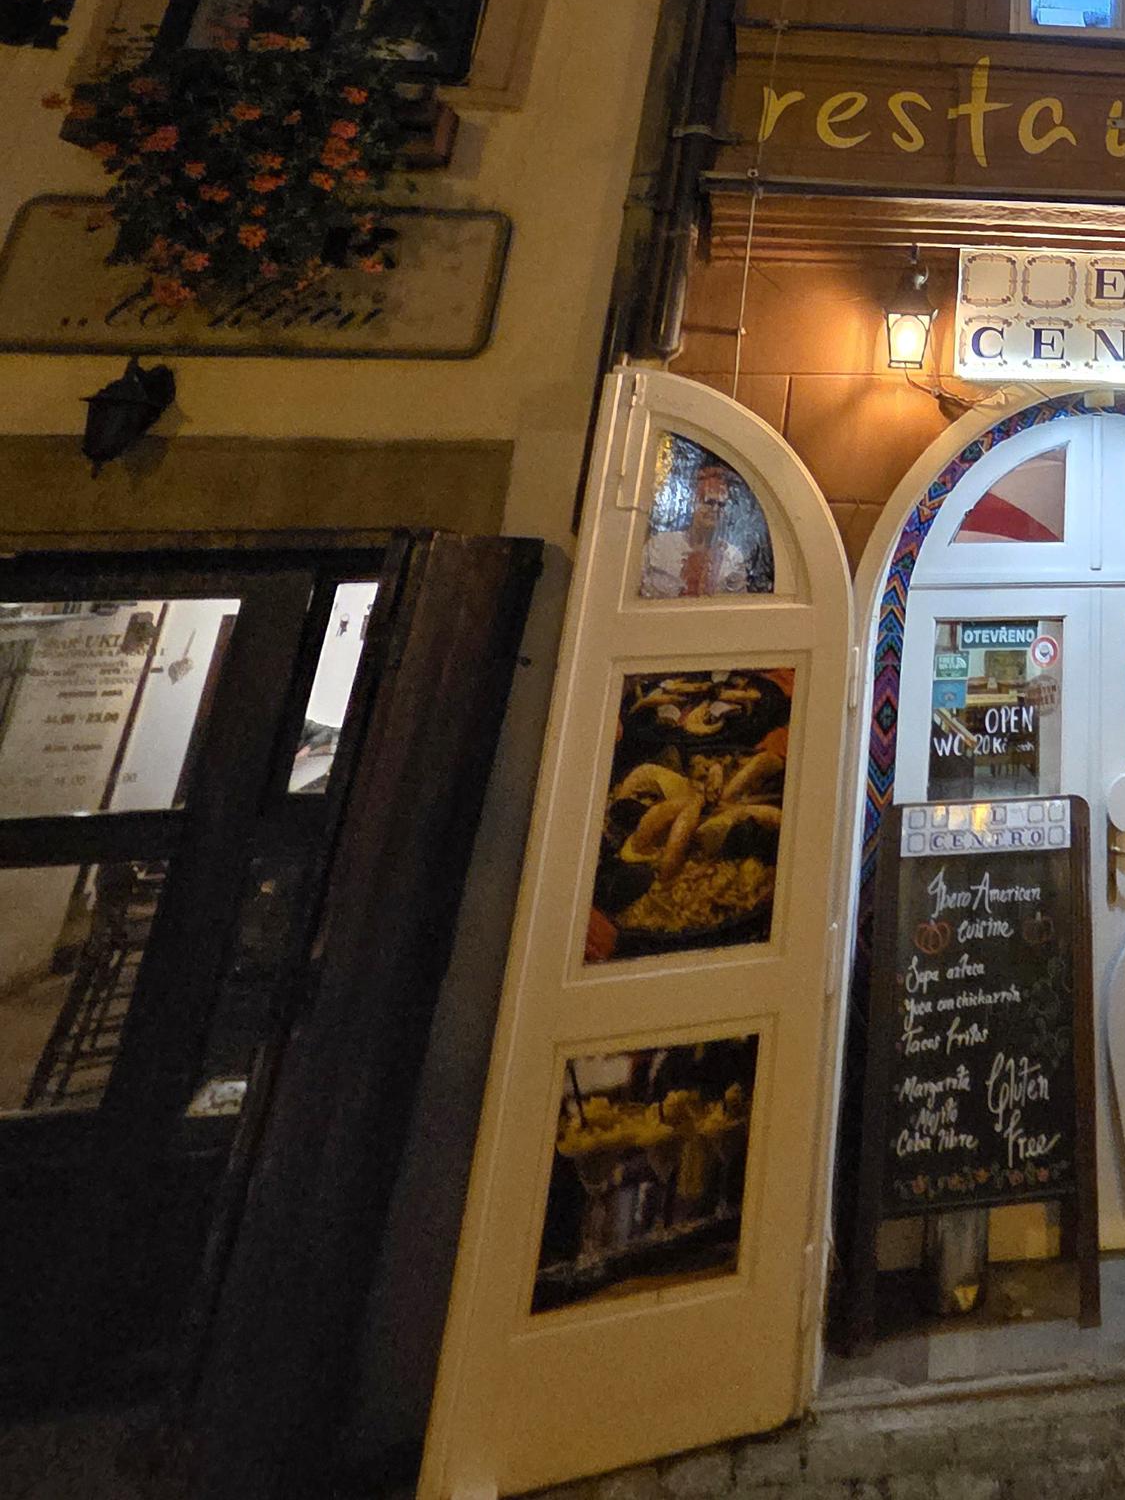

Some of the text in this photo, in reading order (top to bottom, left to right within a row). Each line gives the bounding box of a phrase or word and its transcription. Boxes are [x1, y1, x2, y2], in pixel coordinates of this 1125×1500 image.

[963, 626, 1035, 644] OTEVŘENO
[984, 705, 1034, 734] OPEN
[933, 733, 964, 757] WC
[974, 734, 991, 755] 20
[932, 831, 1042, 849] CENTRO
[970, 871, 1042, 914] American
[901, 1026, 941, 1056] Tacos
